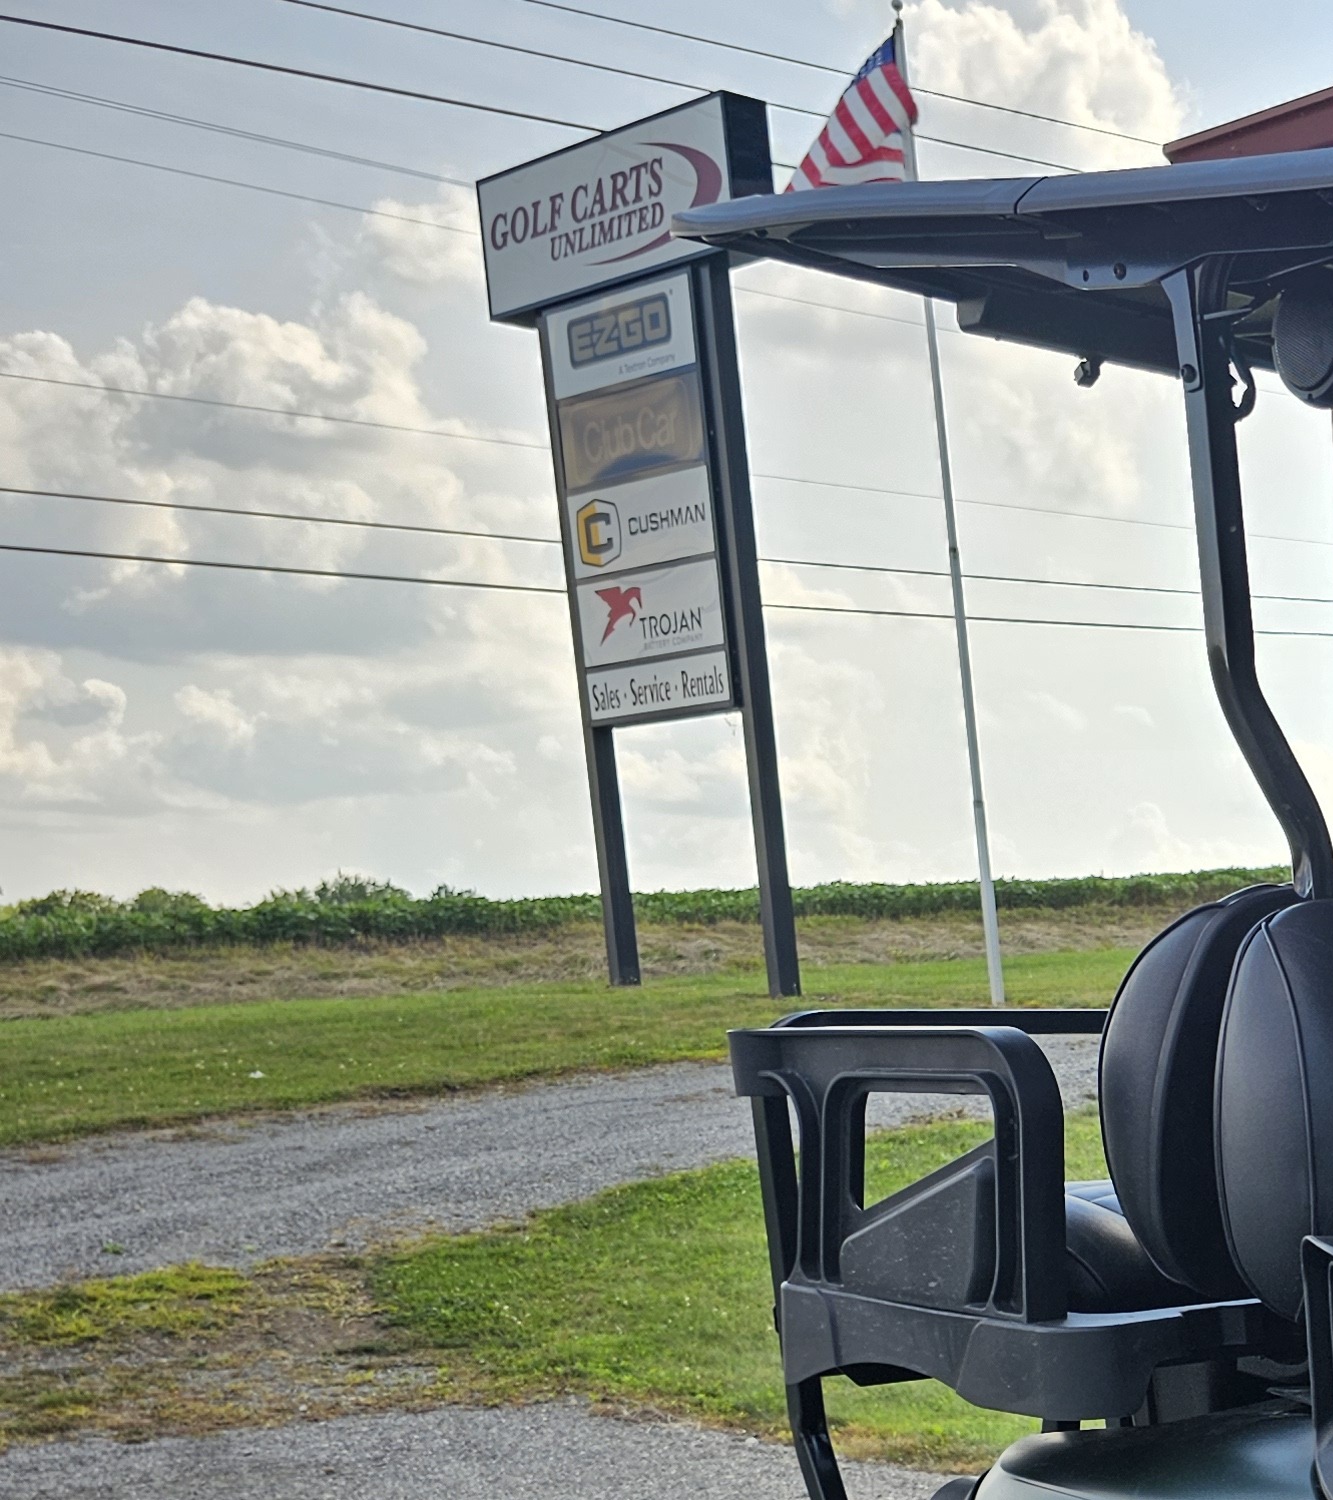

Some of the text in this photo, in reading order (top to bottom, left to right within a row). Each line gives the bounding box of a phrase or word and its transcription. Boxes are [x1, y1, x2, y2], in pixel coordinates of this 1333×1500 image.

[491, 157, 663, 251] GOLF CARTS
[551, 202, 664, 261] UNLIMITED
[628, 502, 706, 536] CUSHMAN
[639, 607, 703, 640] TROJAN
[592, 665, 725, 712] Sales Service Rentals
